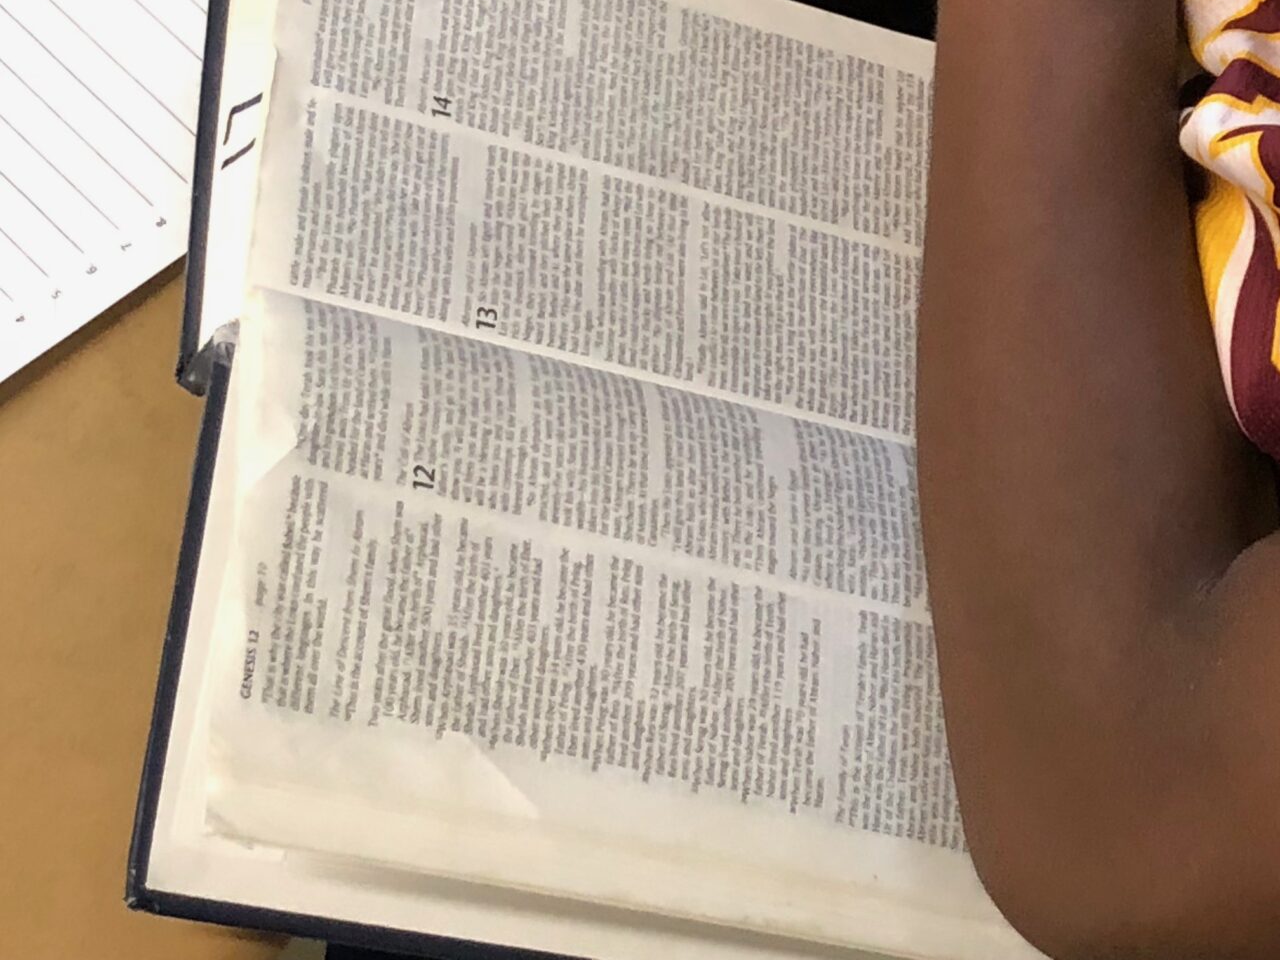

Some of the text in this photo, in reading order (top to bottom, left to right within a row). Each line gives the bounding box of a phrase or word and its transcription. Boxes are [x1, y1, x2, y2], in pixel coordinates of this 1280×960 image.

[431, 95, 452, 117] 14
[475, 306, 497, 329] 13
[412, 464, 435, 489] 12
[240, 648, 256, 699] GENESIS
